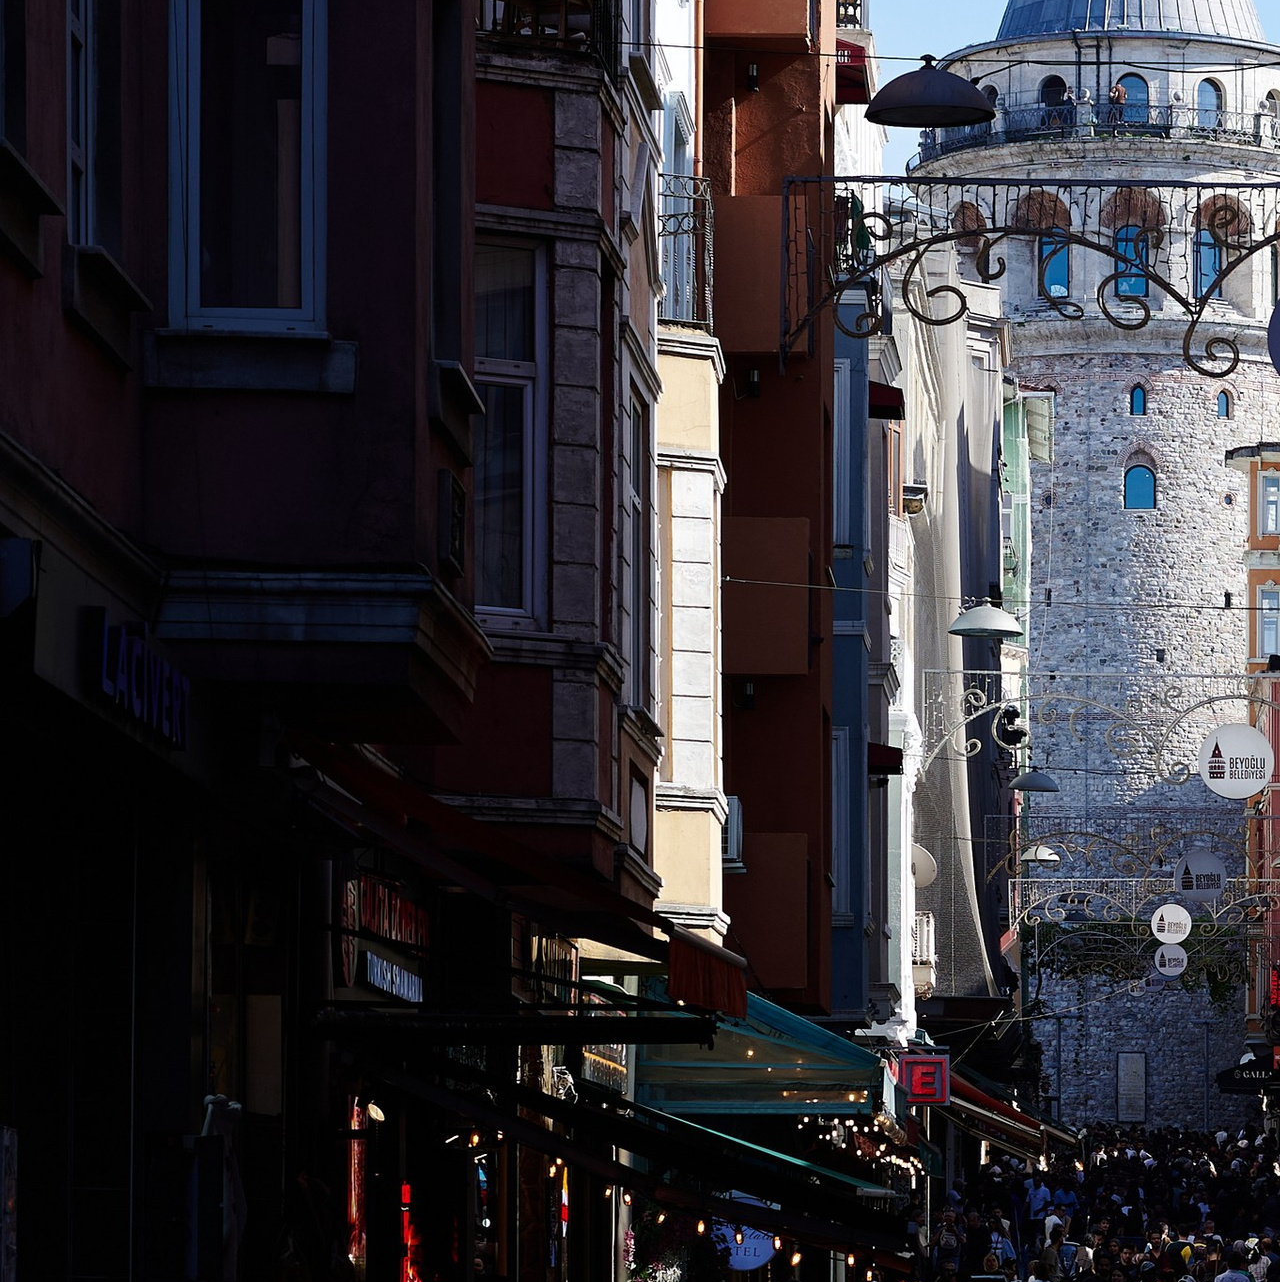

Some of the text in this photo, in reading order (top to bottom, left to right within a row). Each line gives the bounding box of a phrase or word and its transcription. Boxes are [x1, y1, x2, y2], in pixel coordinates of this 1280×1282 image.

[1229, 755, 1266, 769] BEYOĞLU
[1229, 769, 1266, 780] BELEDİYESİ
[1195, 872, 1221, 883] BEYOĞLU
[911, 1065, 937, 1096] E
